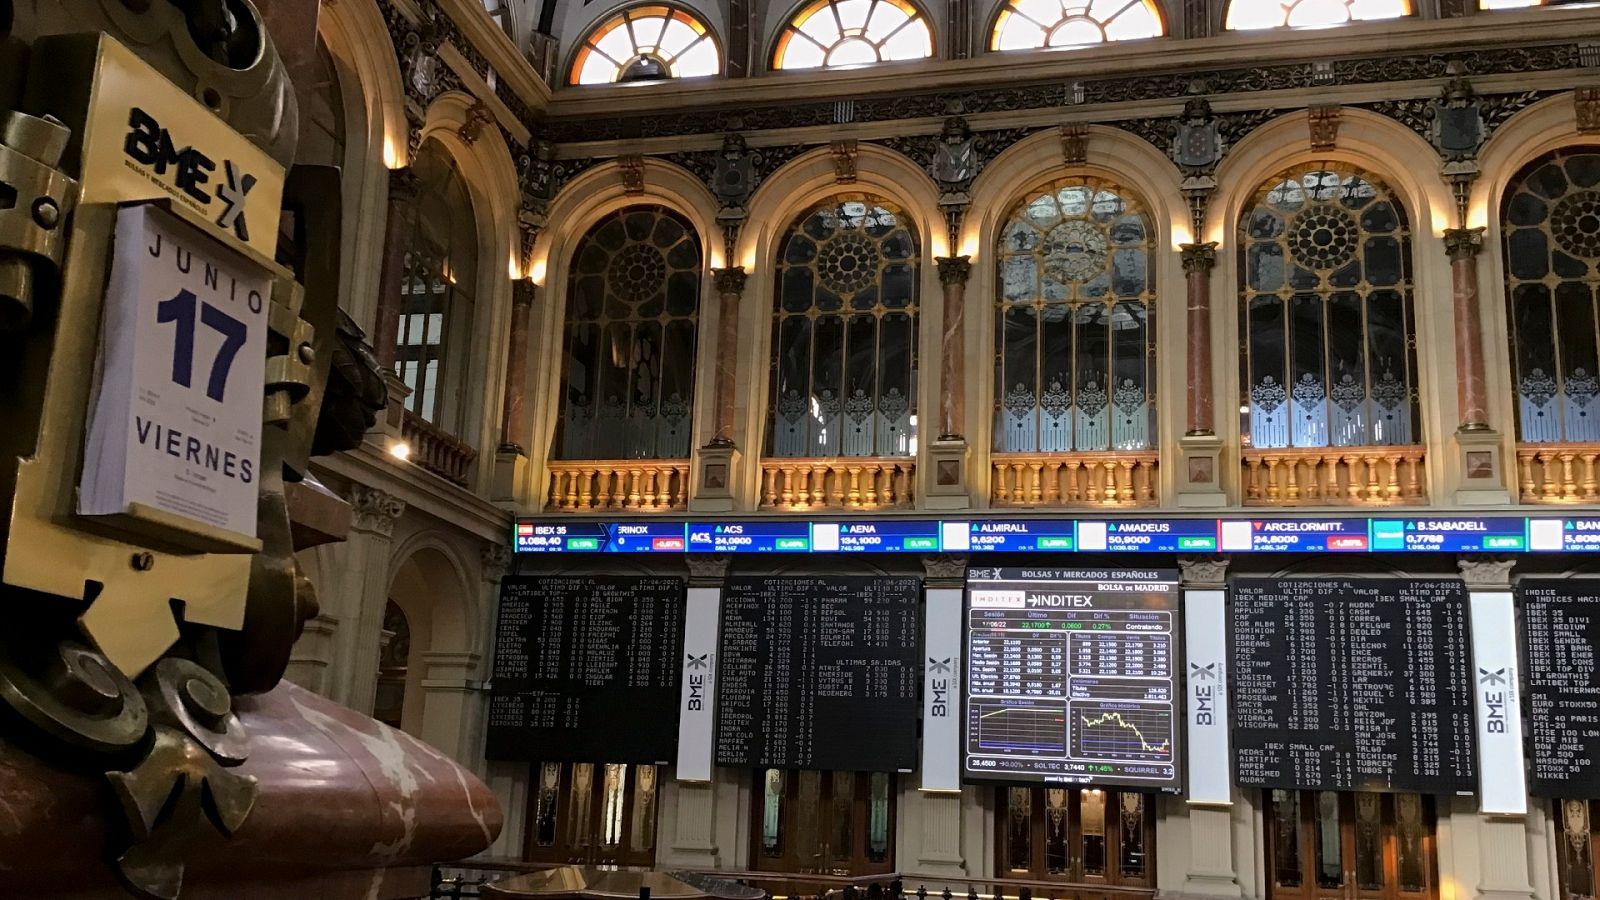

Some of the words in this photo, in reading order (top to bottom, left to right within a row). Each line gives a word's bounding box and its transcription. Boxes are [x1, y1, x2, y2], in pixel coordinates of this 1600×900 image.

[149, 234, 262, 314] JUNIO
[157, 288, 247, 403] 17
[136, 416, 252, 483] VIERNES
[981, 524, 1028, 532] ALMIRALL
[1118, 524, 1169, 532] AMADEUS
[1264, 522, 1344, 531] ARCELORMITT.
[1417, 522, 1487, 530] B.SABADELL
[1038, 595, 1092, 606] INDITEX
[1034, 762, 1060, 770] SOLTEC
